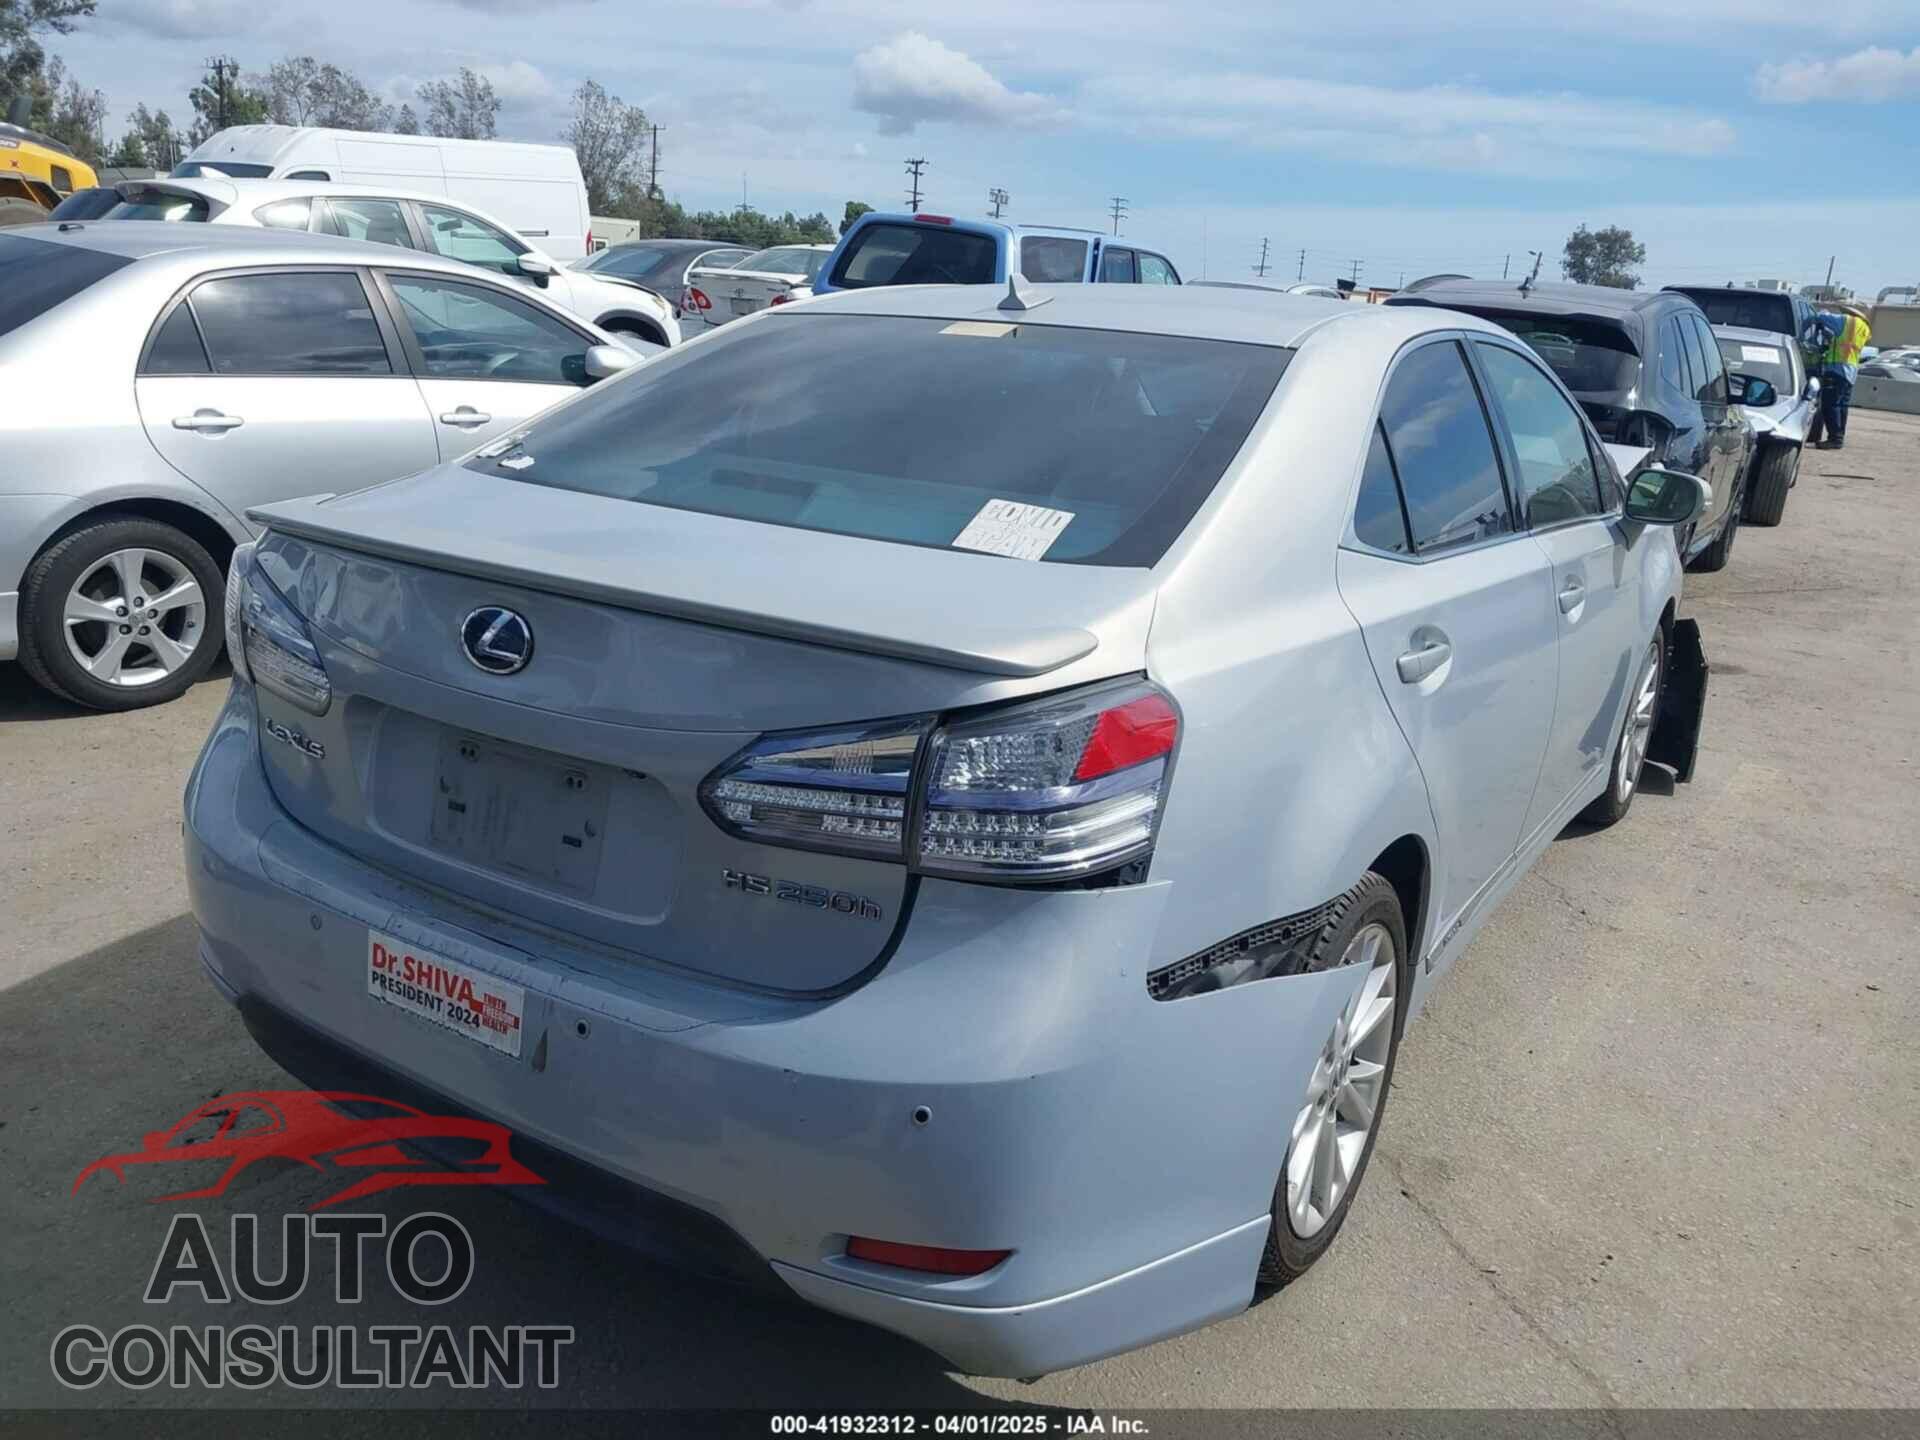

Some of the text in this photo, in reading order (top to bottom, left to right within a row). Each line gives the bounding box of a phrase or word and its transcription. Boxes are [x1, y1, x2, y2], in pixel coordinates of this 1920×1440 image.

[722, 869, 882, 920] HS 250h
[371, 970, 443, 1012] PRESIDENT
[447, 1002, 481, 1028] 2024
